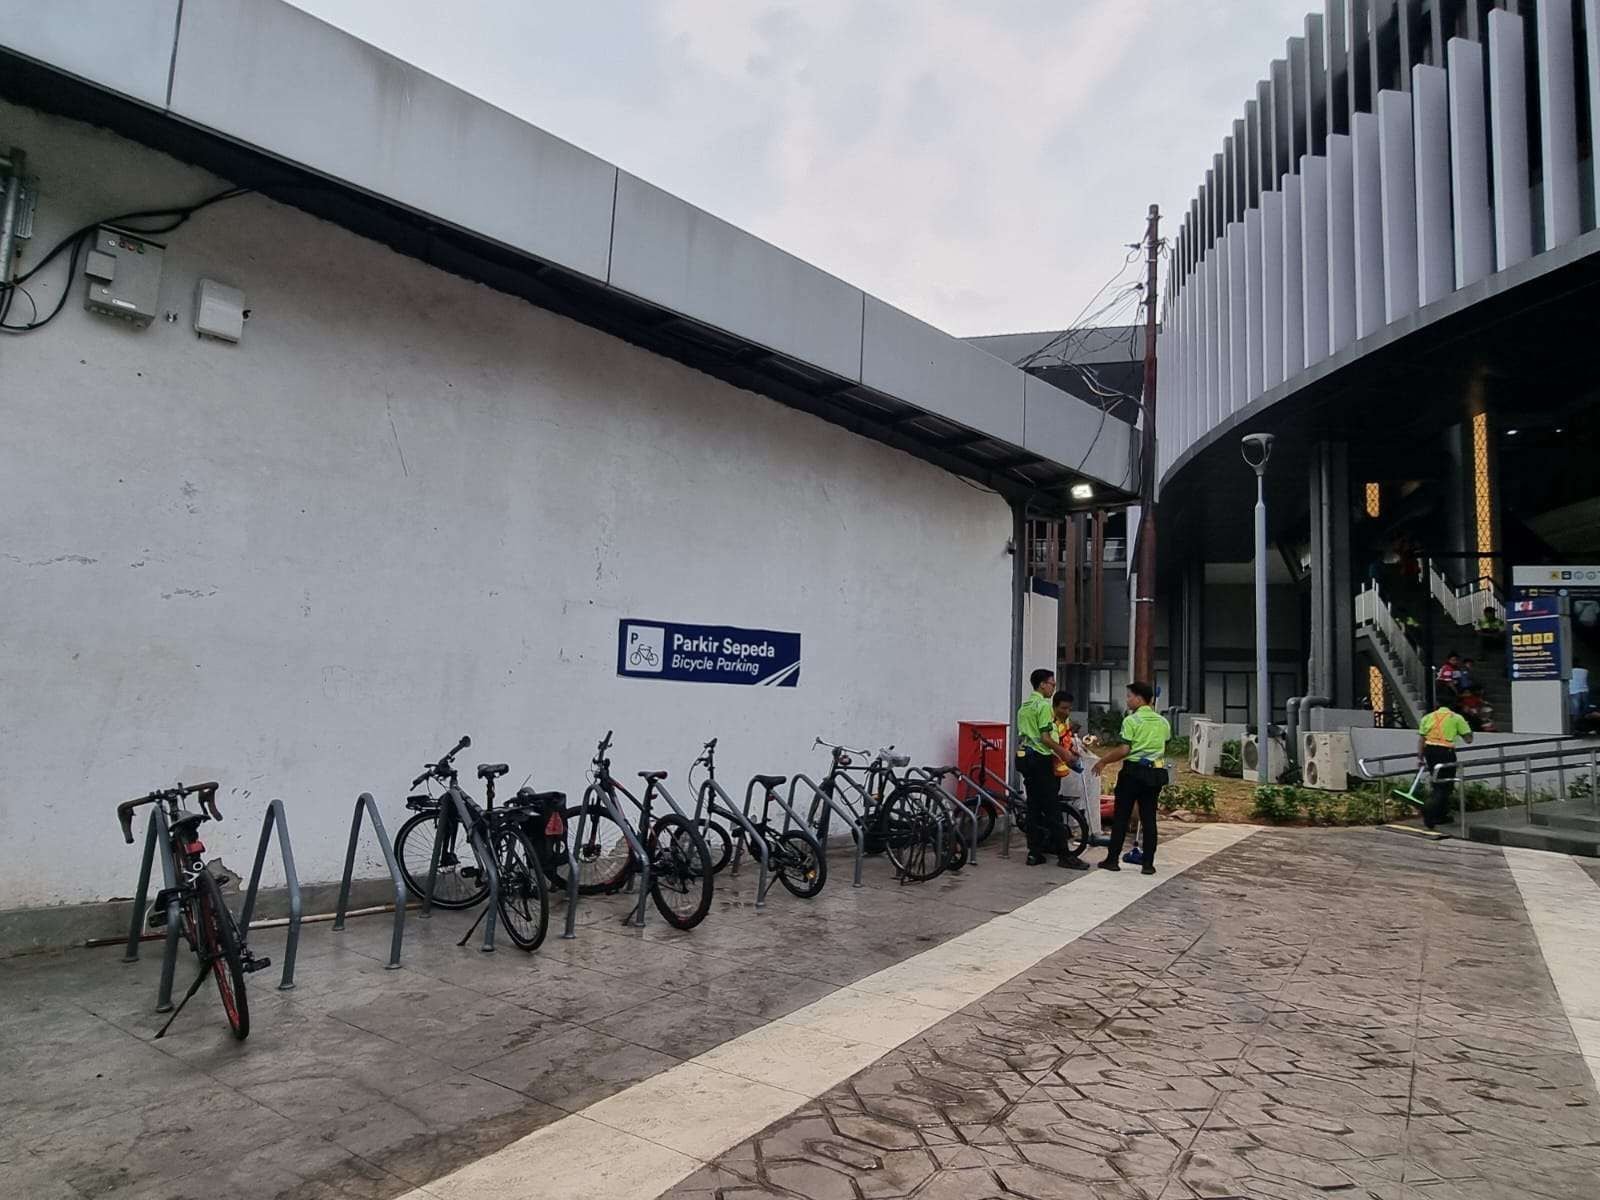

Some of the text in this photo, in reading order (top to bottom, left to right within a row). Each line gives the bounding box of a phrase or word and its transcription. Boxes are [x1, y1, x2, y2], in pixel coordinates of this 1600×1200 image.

[630, 632, 639, 645] P
[673, 633, 776, 659] Parkir Sepeda
[671, 653, 760, 676] Bicycle Parking
